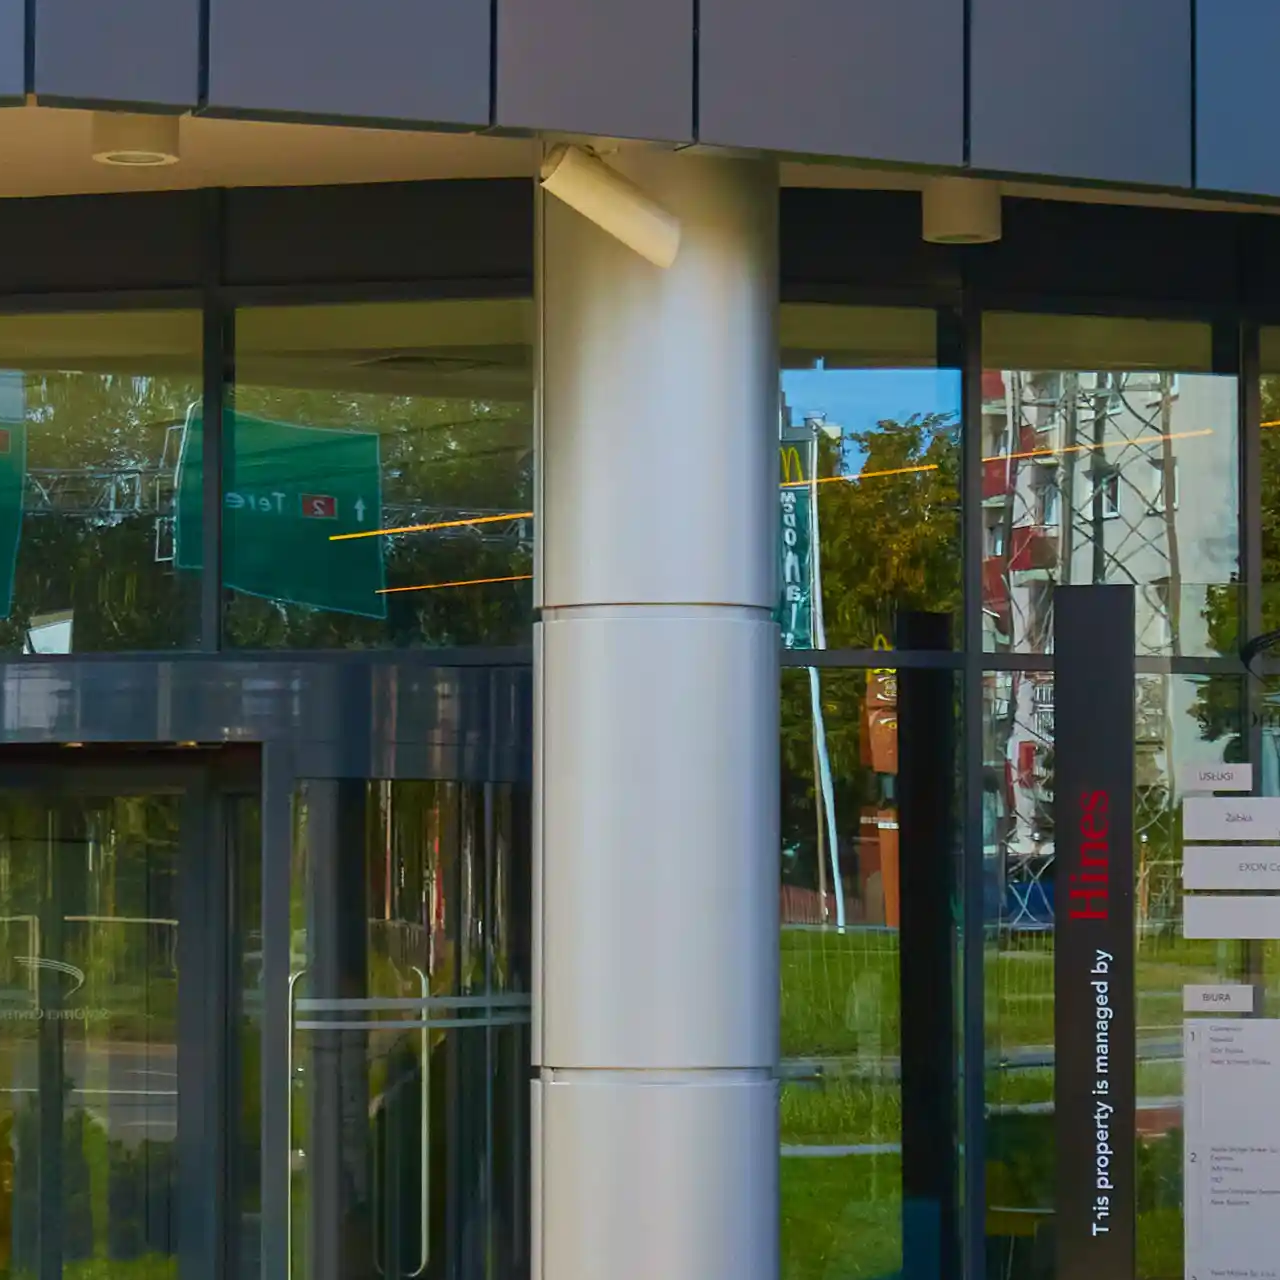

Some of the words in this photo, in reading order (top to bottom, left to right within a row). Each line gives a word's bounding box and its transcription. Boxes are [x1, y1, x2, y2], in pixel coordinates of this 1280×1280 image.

[1068, 790, 1109, 920] Hines
[1239, 862, 1267, 872] EXON
[1091, 949, 1114, 975] by
[1202, 993, 1231, 1003] BIURA
[1094, 981, 1114, 1073] managed
[1091, 1078, 1109, 1095] is
[1094, 1100, 1114, 1190] property
[1190, 1152, 1197, 1163] 2
